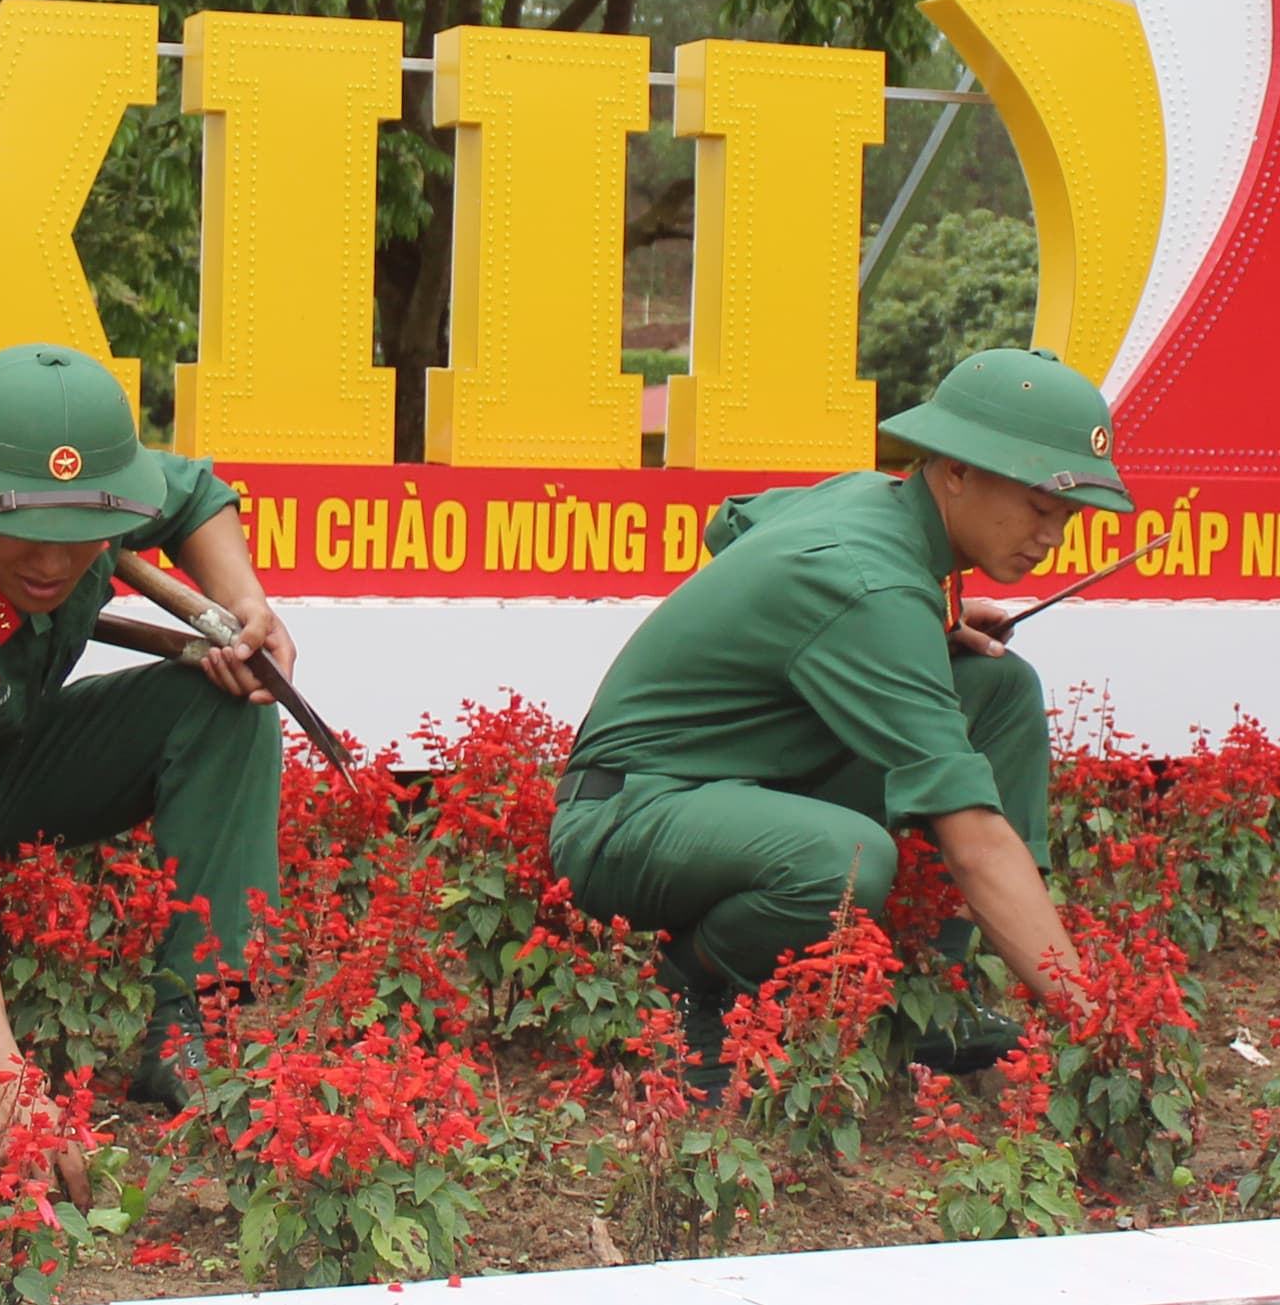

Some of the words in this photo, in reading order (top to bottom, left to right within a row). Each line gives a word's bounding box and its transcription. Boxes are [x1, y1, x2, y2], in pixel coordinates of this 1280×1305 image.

[316, 482, 468, 572] CHÀO
[485, 484, 647, 572] MỪNG
[1135, 487, 1229, 576] CẤP
